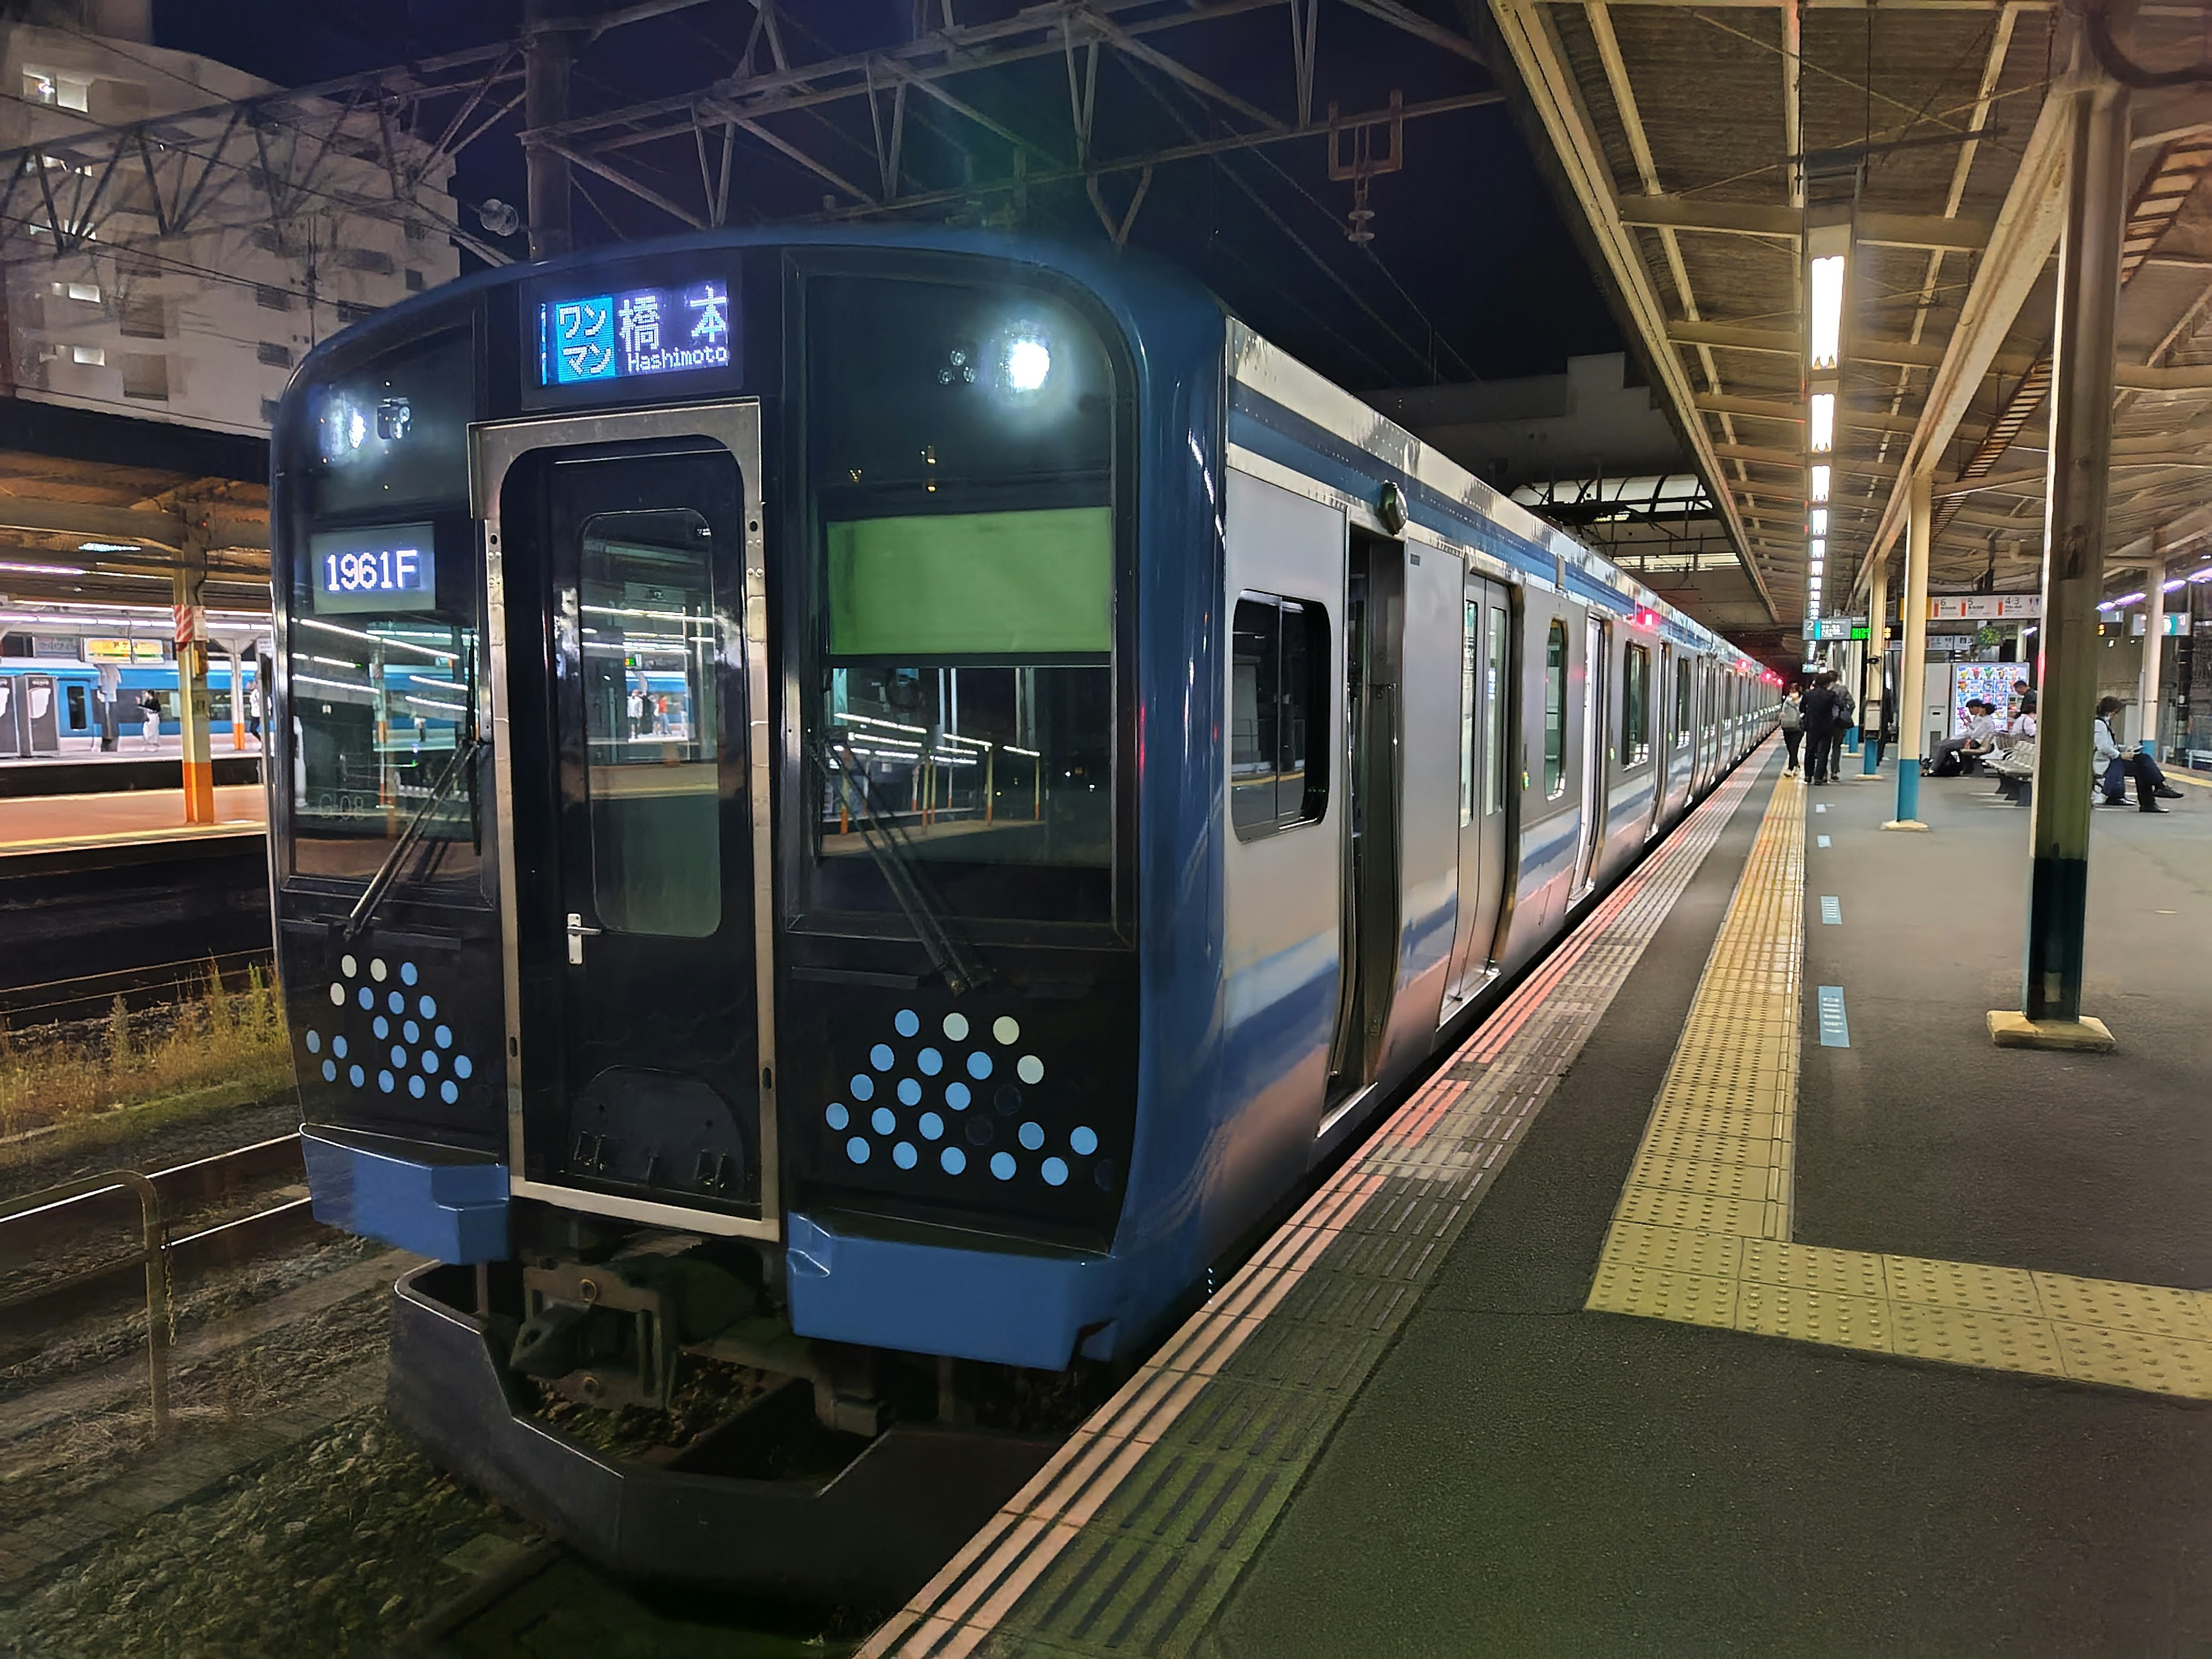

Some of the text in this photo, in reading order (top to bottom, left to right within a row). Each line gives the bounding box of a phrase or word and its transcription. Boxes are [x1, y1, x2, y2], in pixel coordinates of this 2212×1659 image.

[559, 305, 607, 338] ワン
[619, 285, 728, 353] 橋本
[562, 342, 612, 375] マン
[627, 347, 728, 374] Hashimoto
[327, 550, 418, 591] 1961F
[1940, 598, 1946, 606] 6
[1806, 620, 1814, 631] 2
